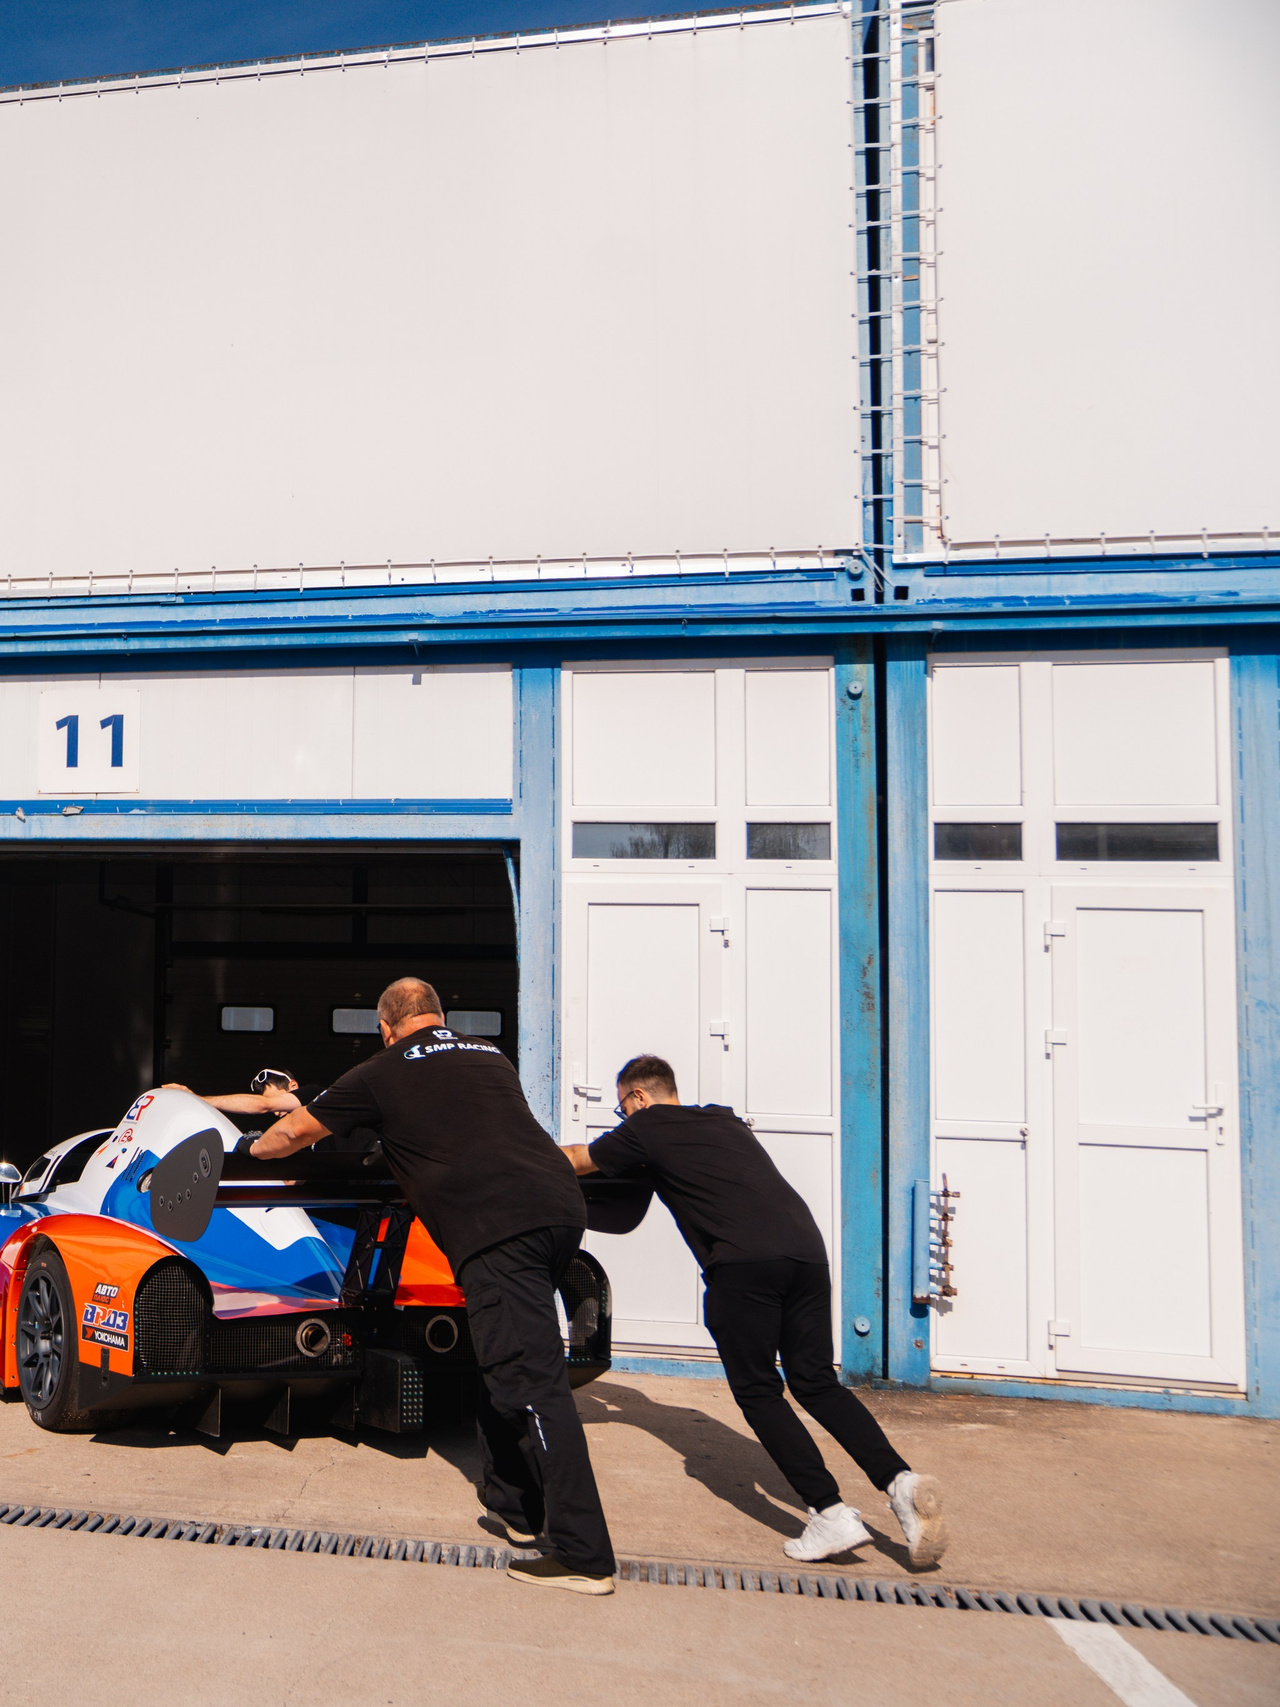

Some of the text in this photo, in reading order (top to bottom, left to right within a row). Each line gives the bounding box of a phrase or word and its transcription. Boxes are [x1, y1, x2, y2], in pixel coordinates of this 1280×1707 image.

[55, 714, 125, 769] 11
[425, 1043, 501, 1054] SMP RACING
[95, 1284, 119, 1298] АВТО
[94, 1330, 126, 1347] YOKOHAMA
